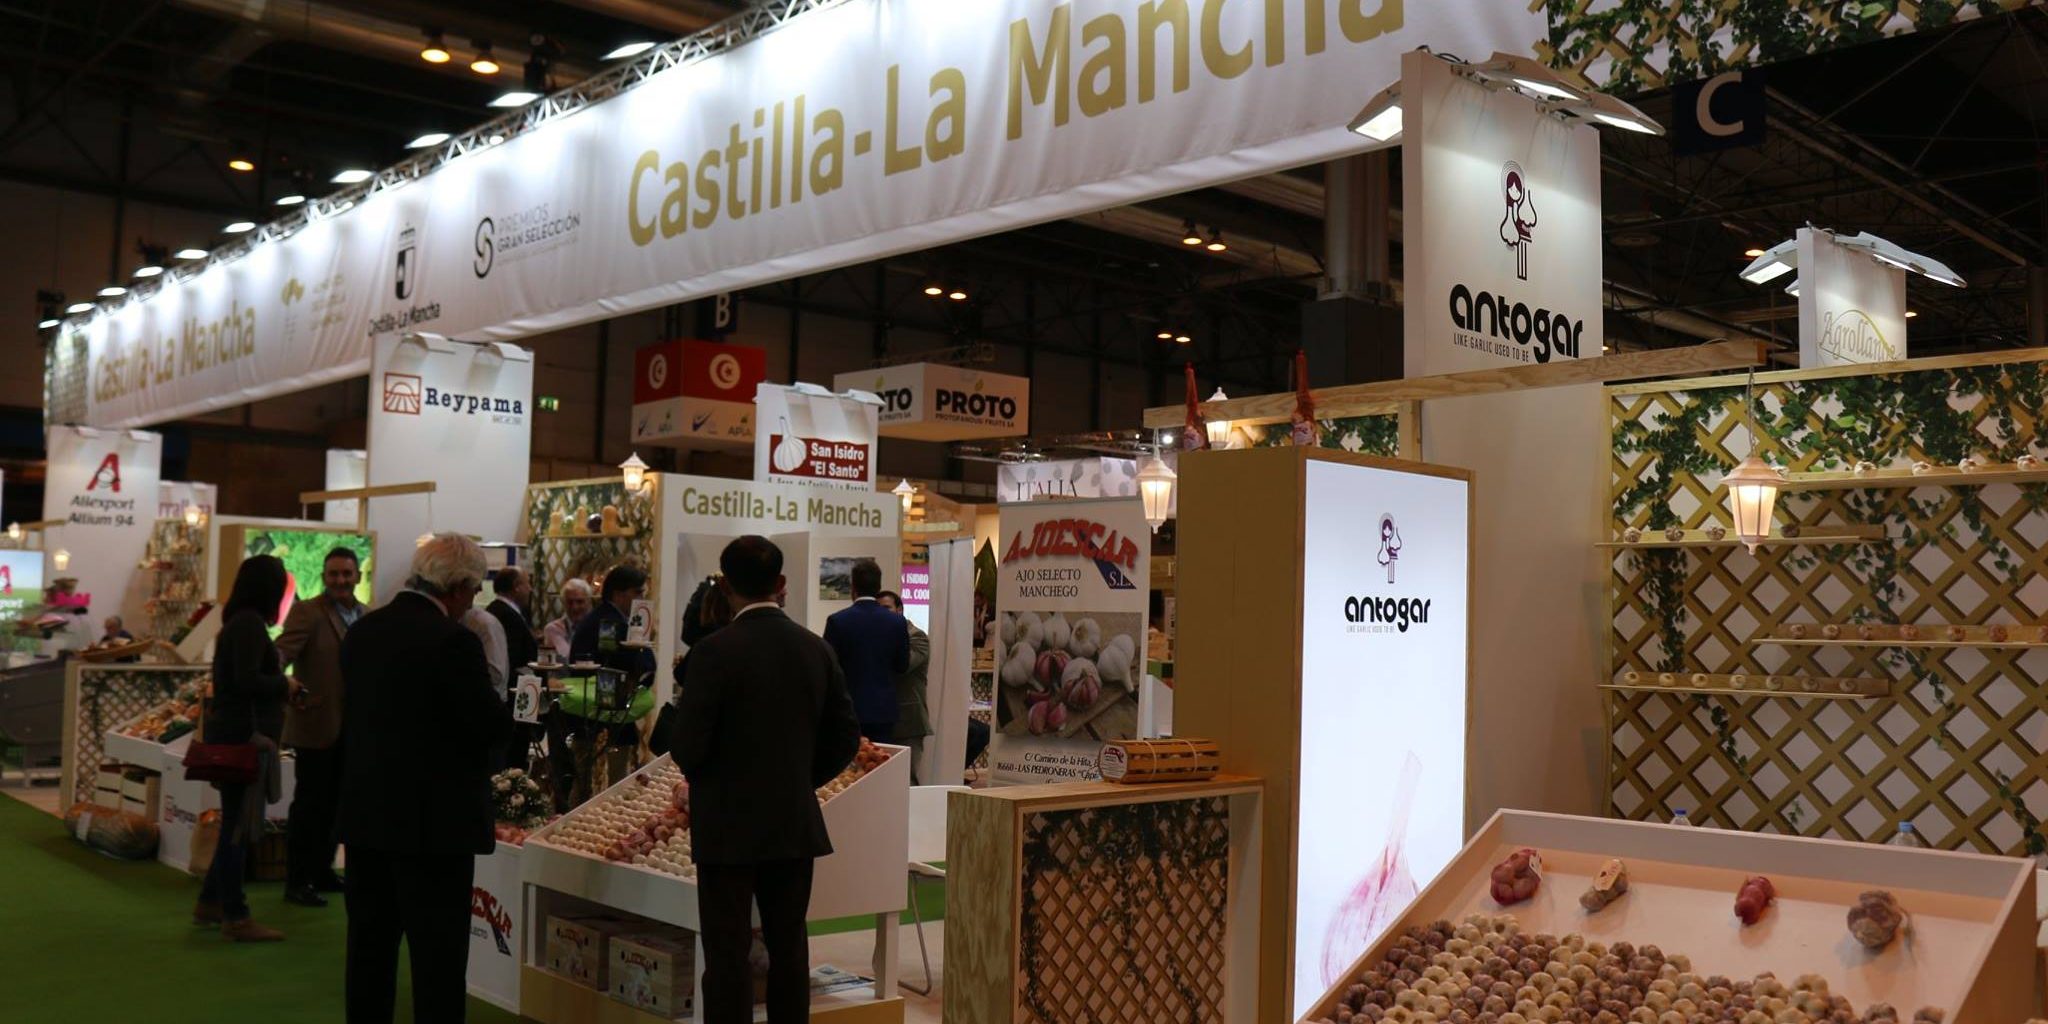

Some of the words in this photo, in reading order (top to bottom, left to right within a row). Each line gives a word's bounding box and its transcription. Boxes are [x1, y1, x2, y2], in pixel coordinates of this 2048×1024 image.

[1696, 71, 1744, 136] C
[628, 64, 966, 247] Castilla-La
[715, 291, 731, 329] B
[1449, 283, 1583, 364] antogar
[1454, 333, 1468, 348] LIKE
[1470, 336, 1492, 353] GARLIC
[1494, 342, 1510, 358] USED
[1512, 347, 1520, 360] TO
[1522, 350, 1529, 363] BE
[424, 387, 523, 414] Reypama
[936, 388, 1016, 419] PROTO
[811, 442, 831, 458] San
[834, 444, 864, 461] Isidro
[810, 460, 826, 475] "El
[829, 462, 864, 478] Santo"
[1017, 479, 1077, 500] ITALIA
[115, 514, 135, 527] 94
[682, 487, 798, 521] Castilla-La
[807, 497, 882, 528] Mancha
[1002, 518, 1138, 569] AJOESCAR
[1016, 569, 1035, 583] AJO
[1038, 568, 1081, 581] SELECTO
[1108, 571, 1132, 587] S.L.
[1019, 585, 1079, 598] MANCHEGO
[1344, 596, 1431, 633] antogar
[1018, 763, 1031, 773] LAS
[1034, 753, 1059, 764] Camino
[1060, 755, 1069, 765] de
[1070, 755, 1076, 766] la
